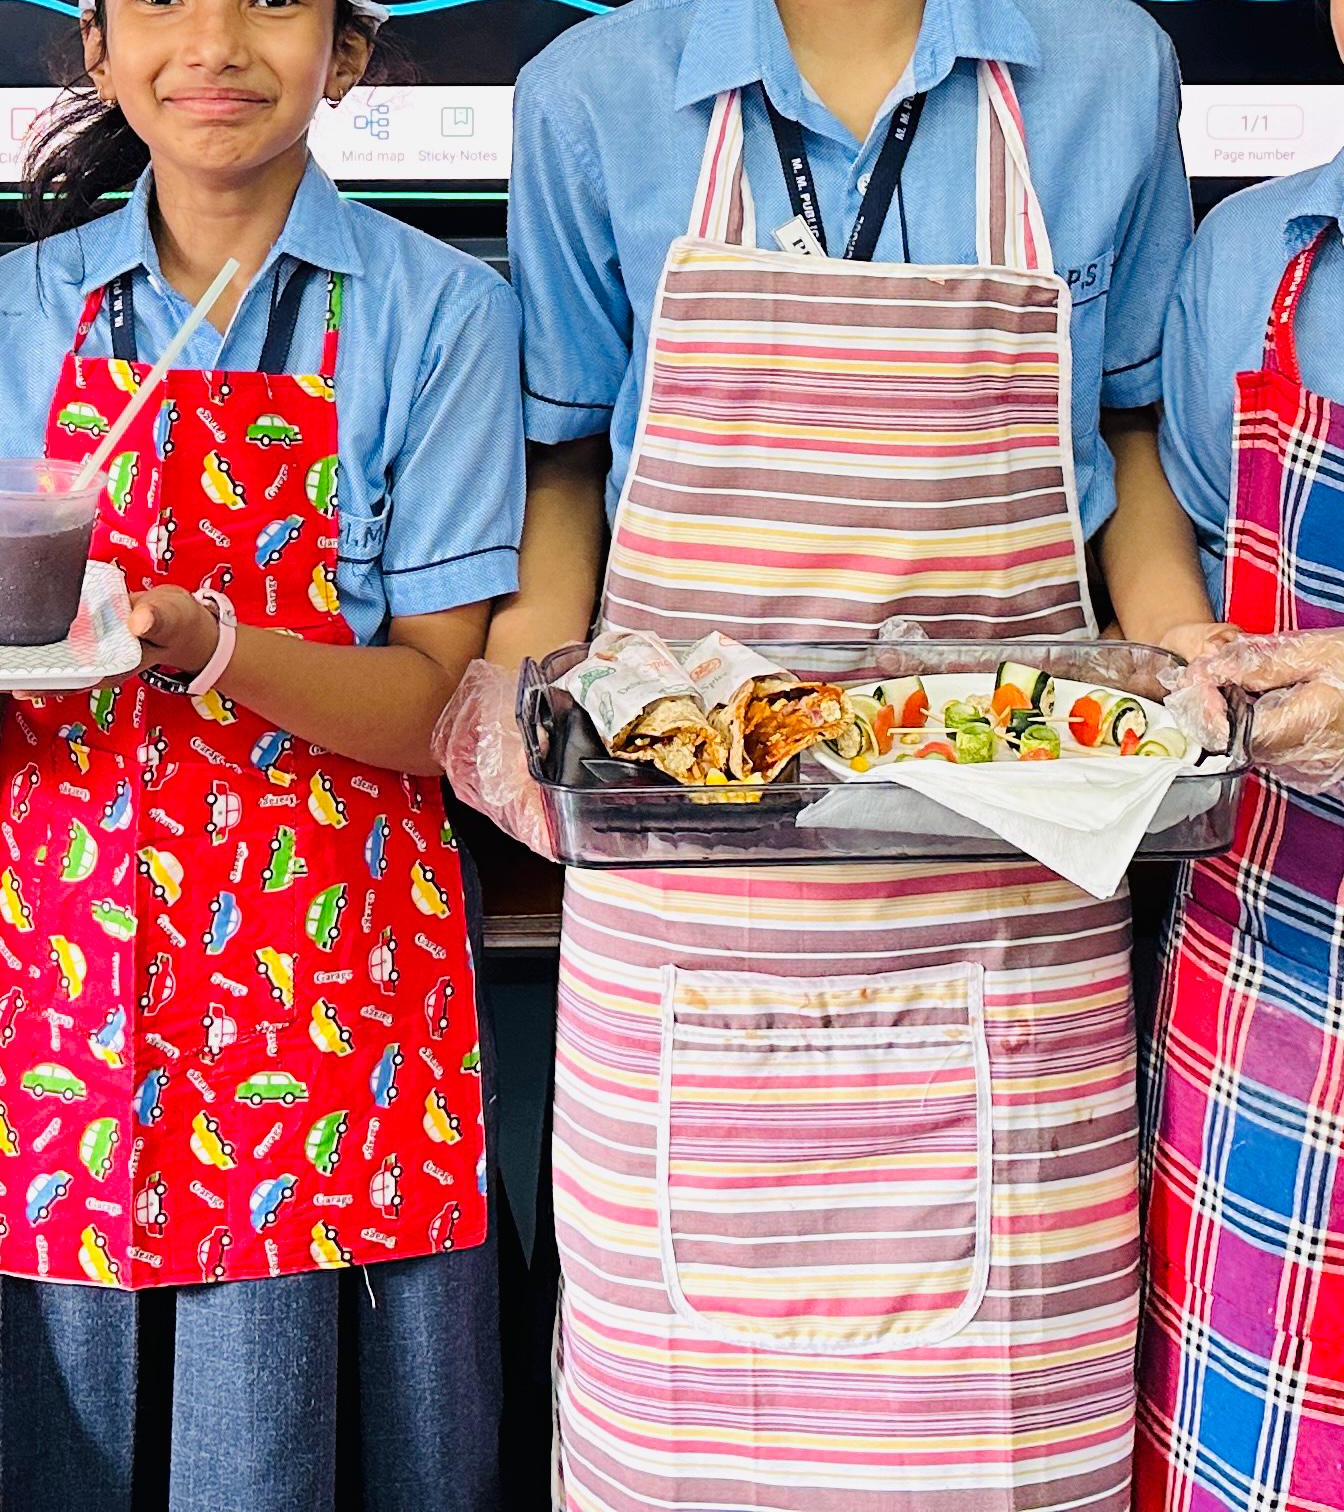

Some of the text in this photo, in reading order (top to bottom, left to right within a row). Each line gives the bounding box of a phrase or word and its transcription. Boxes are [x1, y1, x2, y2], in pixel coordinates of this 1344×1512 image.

[1240, 114, 1269, 133] 1/1
[341, 150, 405, 164] Mind map
[418, 149, 498, 164] Sticky Notes
[1213, 148, 1296, 163] Page number
[317, 536, 338, 548] Gar
